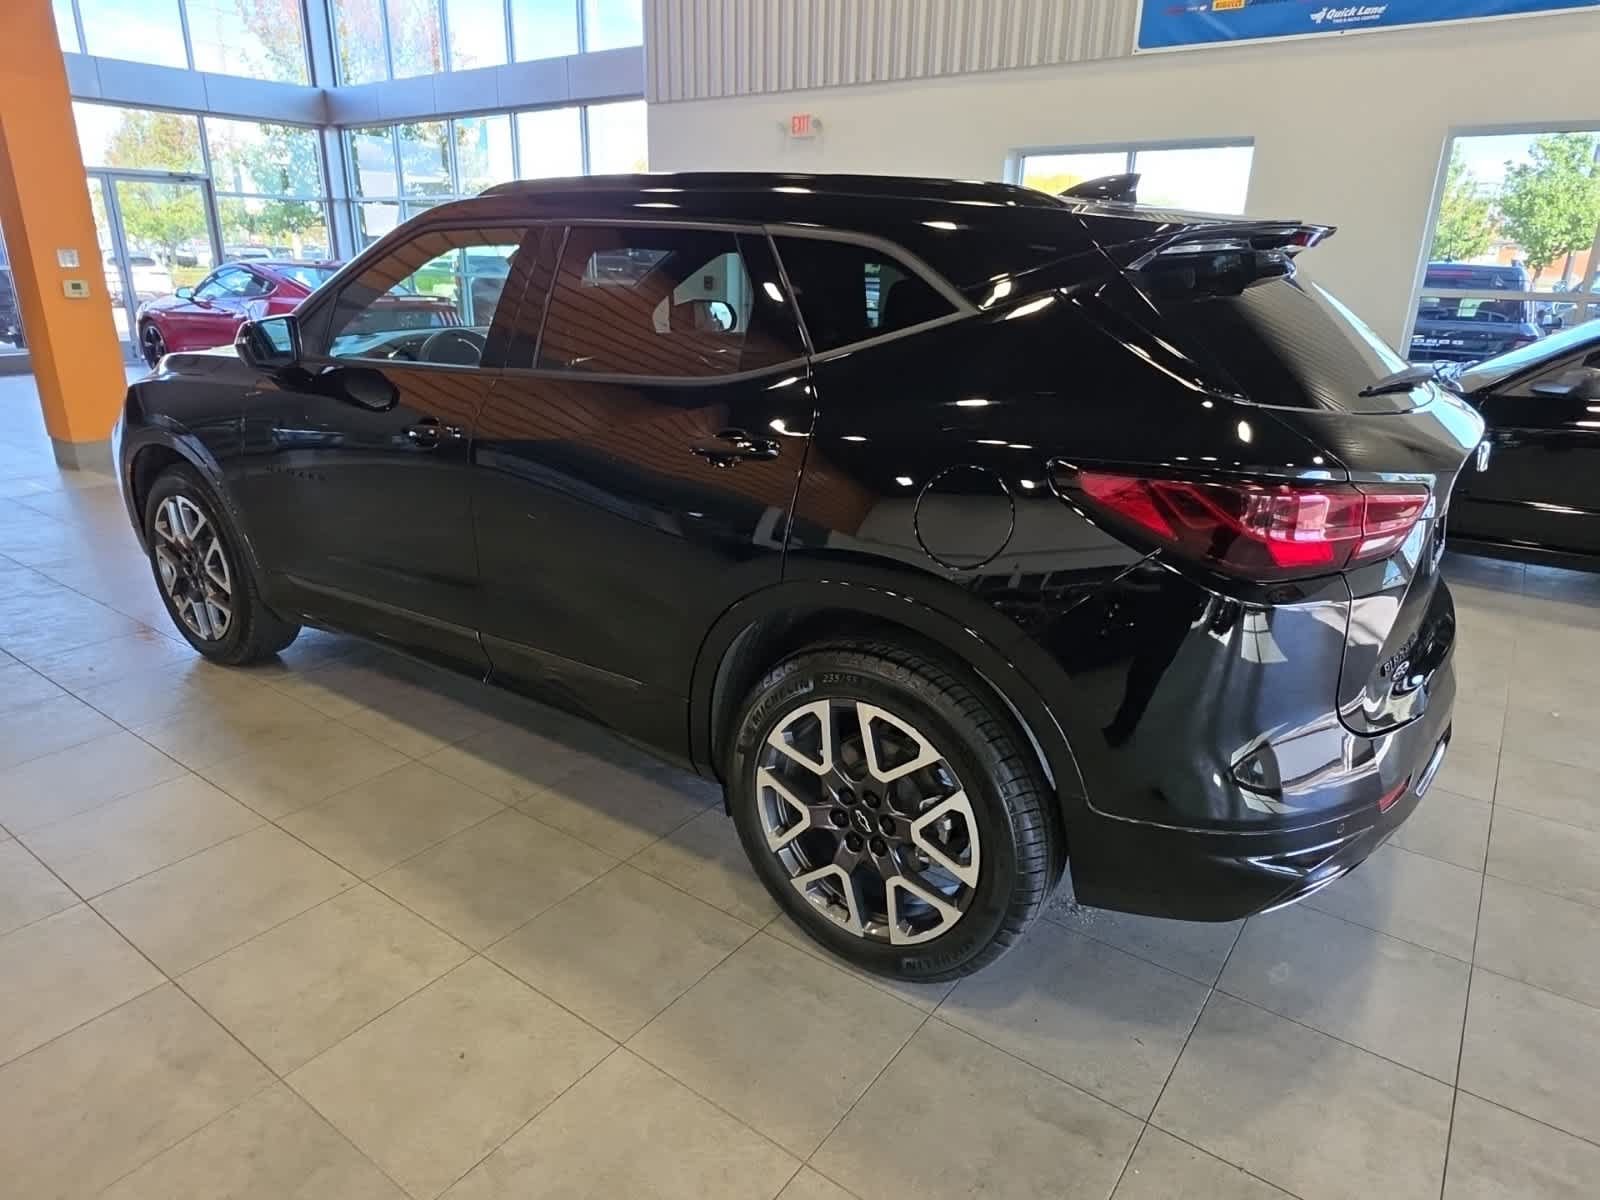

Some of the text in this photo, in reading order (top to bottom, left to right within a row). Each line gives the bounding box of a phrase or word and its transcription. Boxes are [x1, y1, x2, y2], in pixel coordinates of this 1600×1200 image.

[1327, 5, 1386, 19] Quick Lane
[792, 115, 809, 134] EXIT
